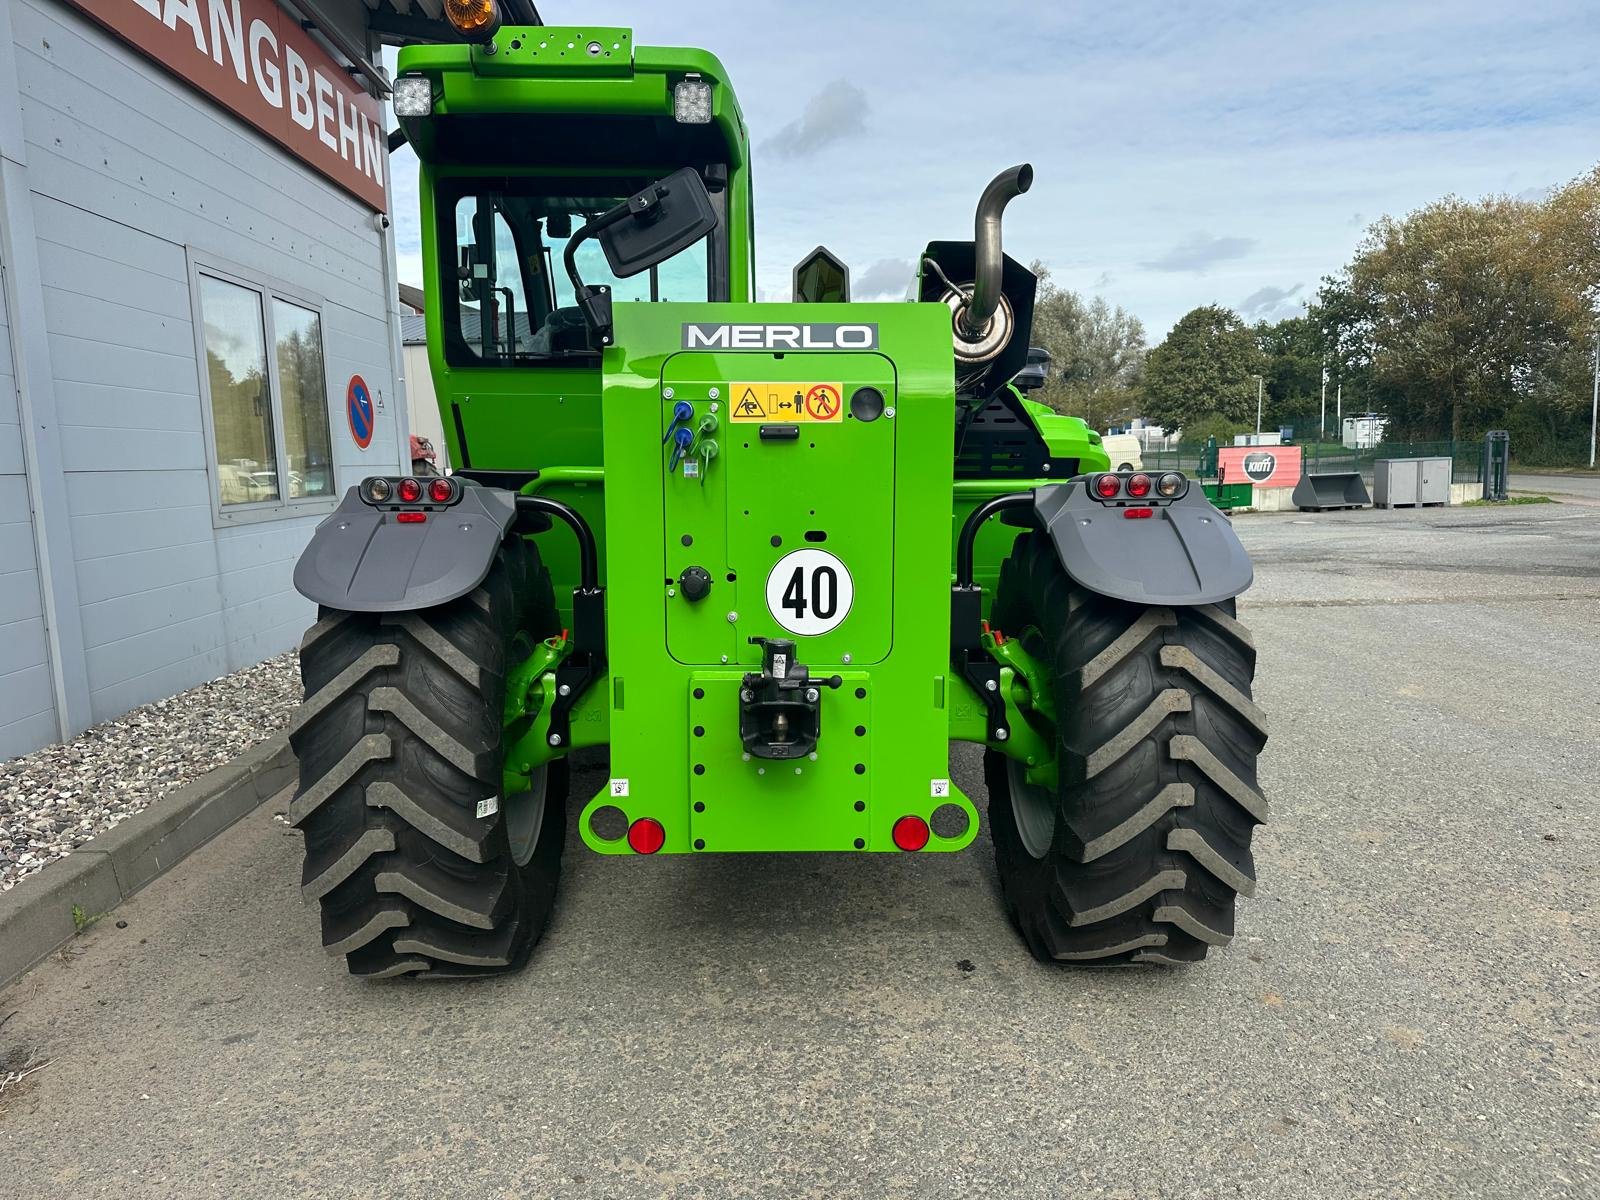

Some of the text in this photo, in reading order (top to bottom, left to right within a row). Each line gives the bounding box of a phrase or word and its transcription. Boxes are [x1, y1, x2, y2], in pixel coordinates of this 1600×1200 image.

[132, 0, 384, 188] ANGBEHN
[687, 325, 873, 348] MERLO
[781, 565, 838, 620] 40
